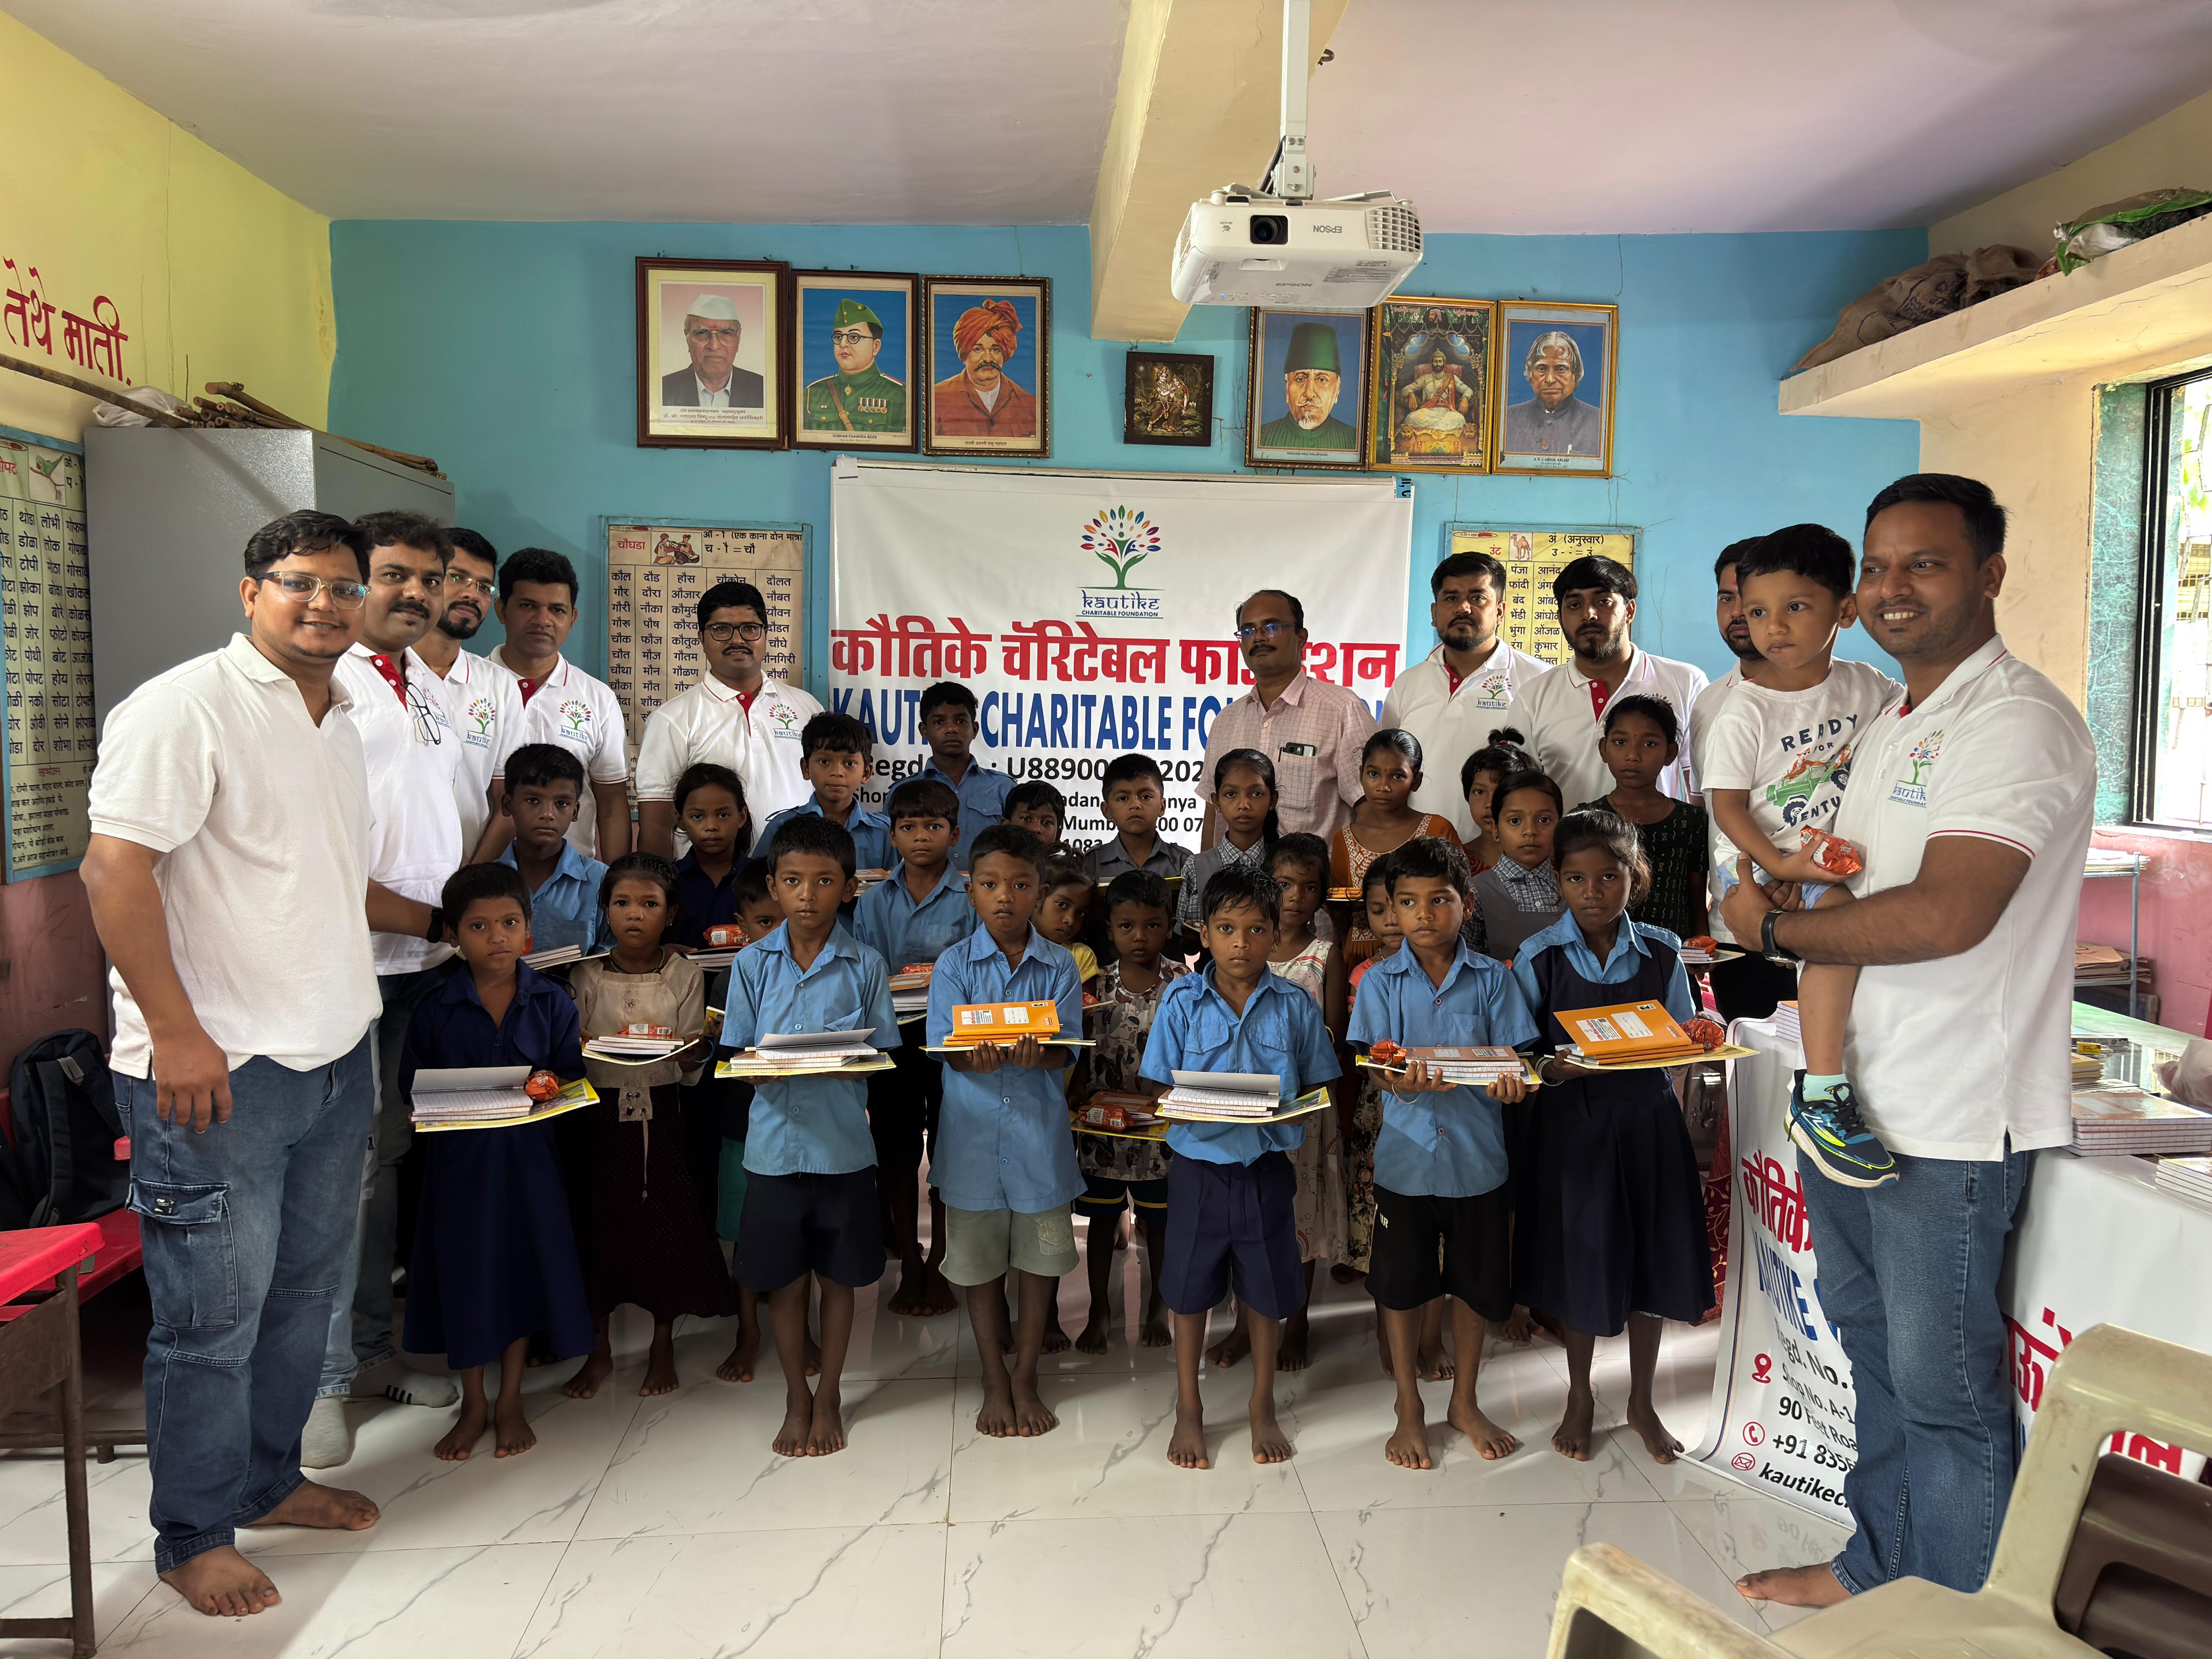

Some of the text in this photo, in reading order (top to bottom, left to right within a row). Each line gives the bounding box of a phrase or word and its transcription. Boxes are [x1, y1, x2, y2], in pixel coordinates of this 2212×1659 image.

[1313, 225, 1342, 234] EPSON
[3, 256, 131, 387] तेथे माती.
[19, 531, 38, 549] डोळा
[44, 535, 60, 552] लोक
[617, 538, 646, 550] चौघडा
[770, 531, 784, 541] दोन
[1548, 532, 1604, 547] अं (अनुस्वार)
[705, 544, 713, 553] च
[744, 542, 755, 554] चौ
[1489, 544, 1502, 556] उंट
[20, 555, 38, 572] टोपी
[1511, 564, 1561, 575] पंजा आनंद
[19, 577, 41, 595] झोका
[611, 569, 631, 581] कौल
[643, 571, 660, 582] दौड
[677, 572, 696, 583] हौस
[766, 574, 791, 586] दौलत
[1509, 579, 1529, 589] फांदी
[613, 585, 791, 602] गौर दौरा औजार नौबत
[1081, 590, 1160, 610] kautike
[1512, 593, 1526, 604] बंद
[23, 600, 39, 617] झोप
[52, 604, 64, 618] बोरे
[611, 601, 631, 613] गौरी
[640, 602, 663, 614] नौका
[765, 605, 791, 617] यौवन
[1510, 608, 1526, 619] भेंडी
[24, 623, 39, 640] जोर
[49, 625, 67, 641] फोटो
[612, 616, 790, 633] गौरू पौष कौरव दौडत
[1510, 624, 1561, 638] भुंगा ओंजळ
[611, 632, 787, 649] चौक फौज कौतुक चौघे
[831, 614, 992, 679] कौतिके
[1001, 619, 1170, 684] चॅरिटेबल
[1511, 639, 1522, 649] रंग
[1534, 640, 1558, 653] कुंभार
[25, 646, 66, 663] पोथी बोट
[611, 648, 631, 659] चौत
[642, 649, 661, 660] मौज
[674, 650, 698, 661] गौतम
[25, 669, 44, 685] पोपट
[52, 669, 68, 686] होय
[610, 663, 789, 680] चौथा मौन गौळण हौशी
[609, 678, 660, 691] चौका मौत
[28, 692, 43, 708] नको
[52, 692, 70, 708] सोटा
[640, 696, 662, 707] शौक
[30, 713, 69, 730] ओवी सोने
[833, 688, 928, 745] KAUT
[981, 691, 1172, 750] CHARITABLE
[53, 736, 72, 752] शोभा
[872, 753, 924, 782] egd
[1892, 782, 1926, 801] kautik
[1063, 816, 1117, 831] Mumb
[1779, 1396, 1802, 1421] 90
[1829, 1424, 1858, 1453] Roa
[1772, 1434, 1857, 1472] +91 8356
[1758, 1462, 1849, 1509] kautikec
